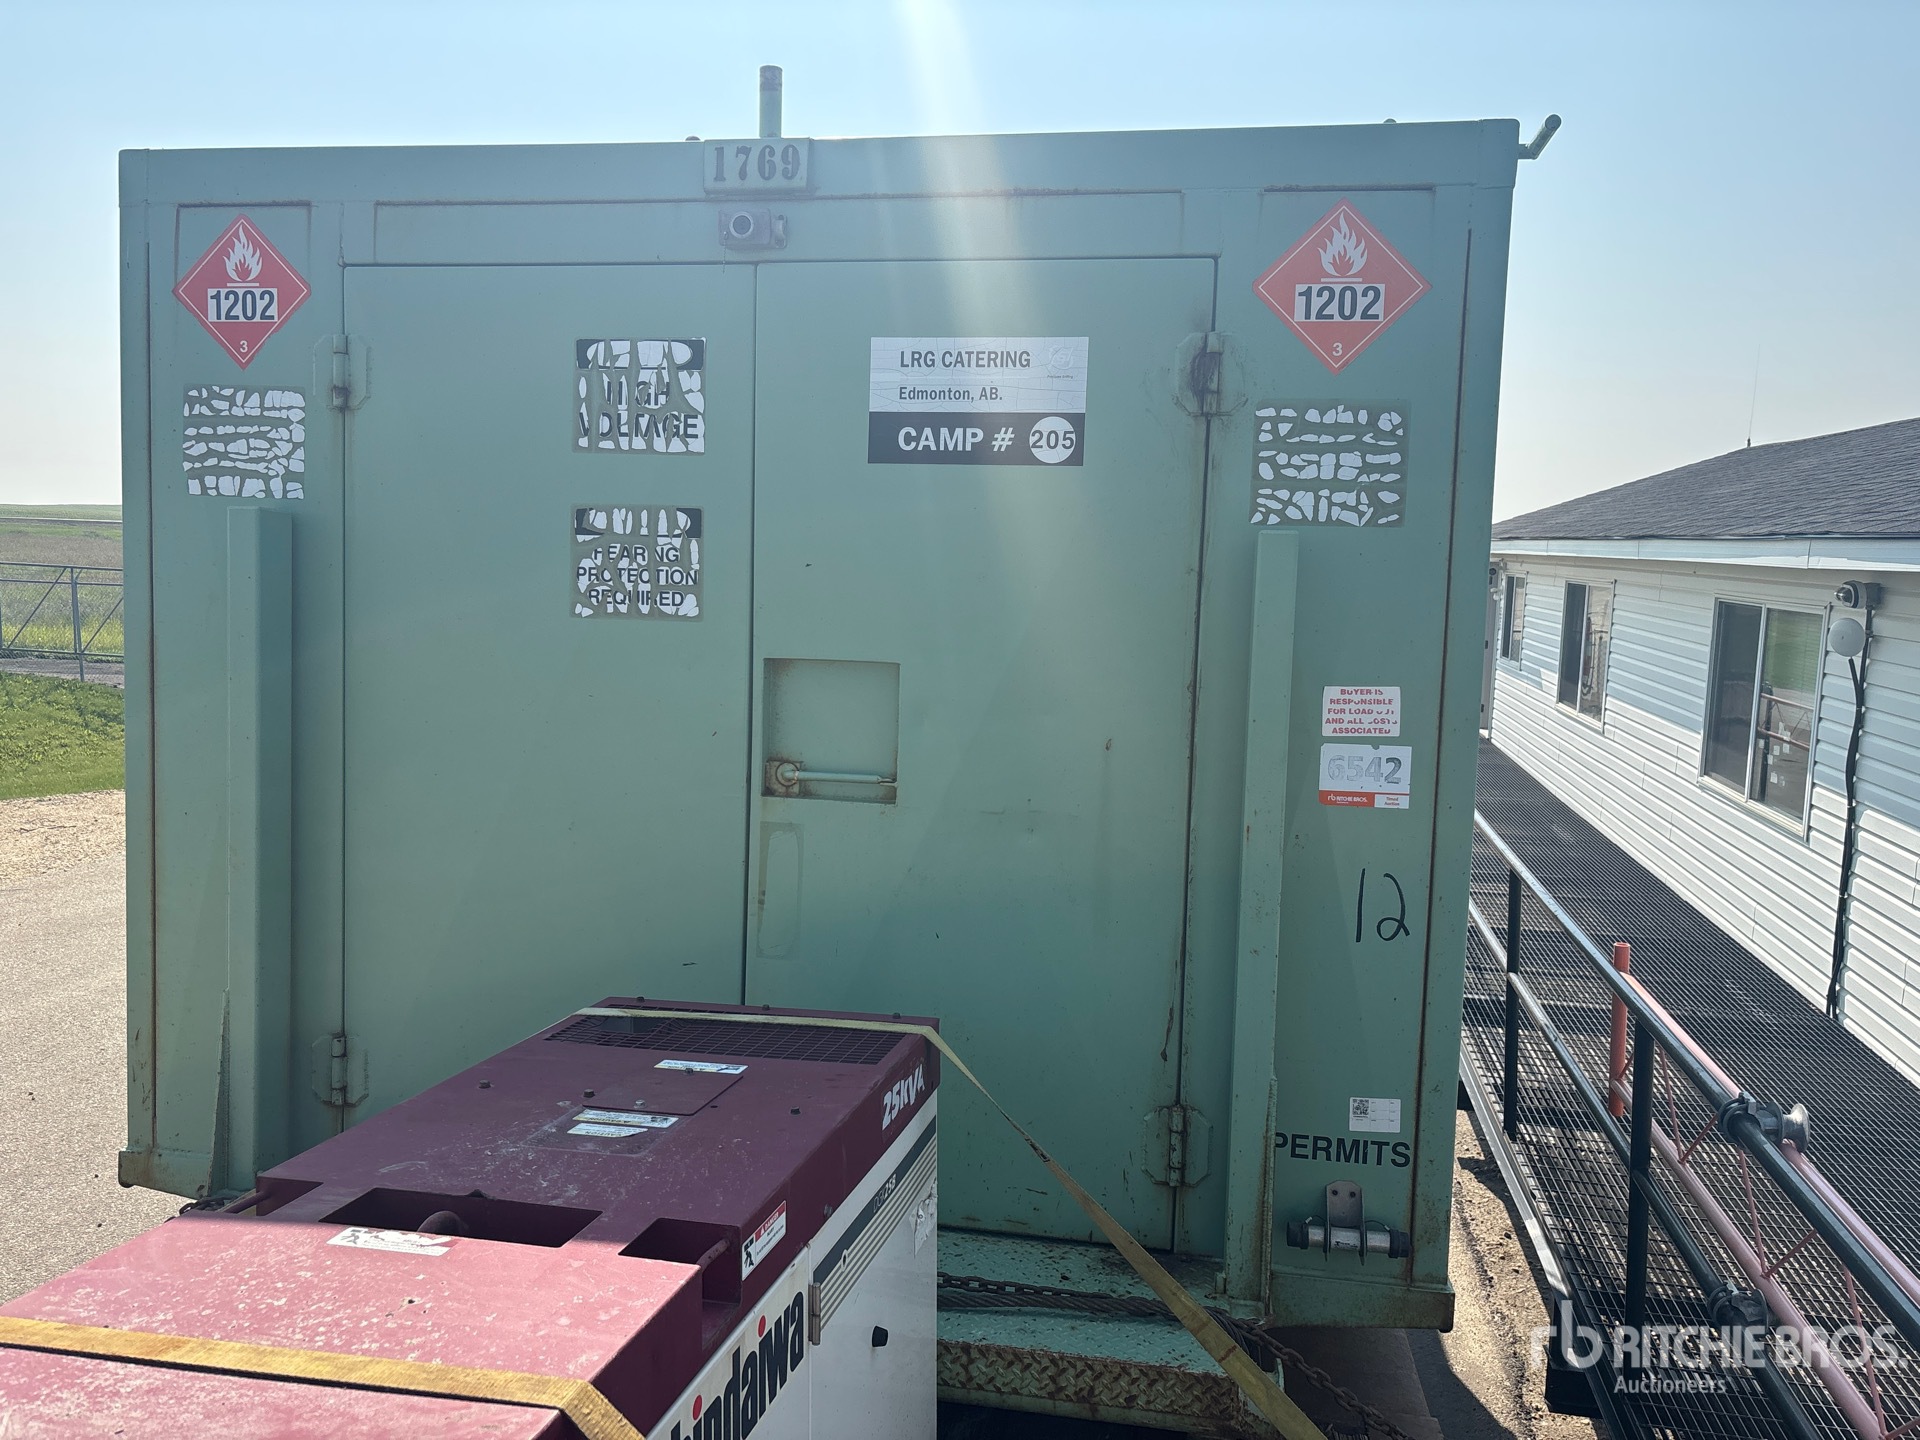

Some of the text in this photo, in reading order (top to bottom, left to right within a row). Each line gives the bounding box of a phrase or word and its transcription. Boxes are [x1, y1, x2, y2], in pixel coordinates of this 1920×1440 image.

[713, 144, 801, 182] 1769
[210, 289, 276, 321] 1202
[1298, 285, 1382, 320] 1202
[240, 340, 249, 353] 3
[899, 350, 1031, 369] LRG CATERING
[1332, 343, 1343, 356] 3
[899, 386, 1003, 403] Edmonton, AB.
[897, 426, 1075, 452] CAMP # 205
[1327, 754, 1402, 785] 6542
[1355, 867, 1411, 943] 12
